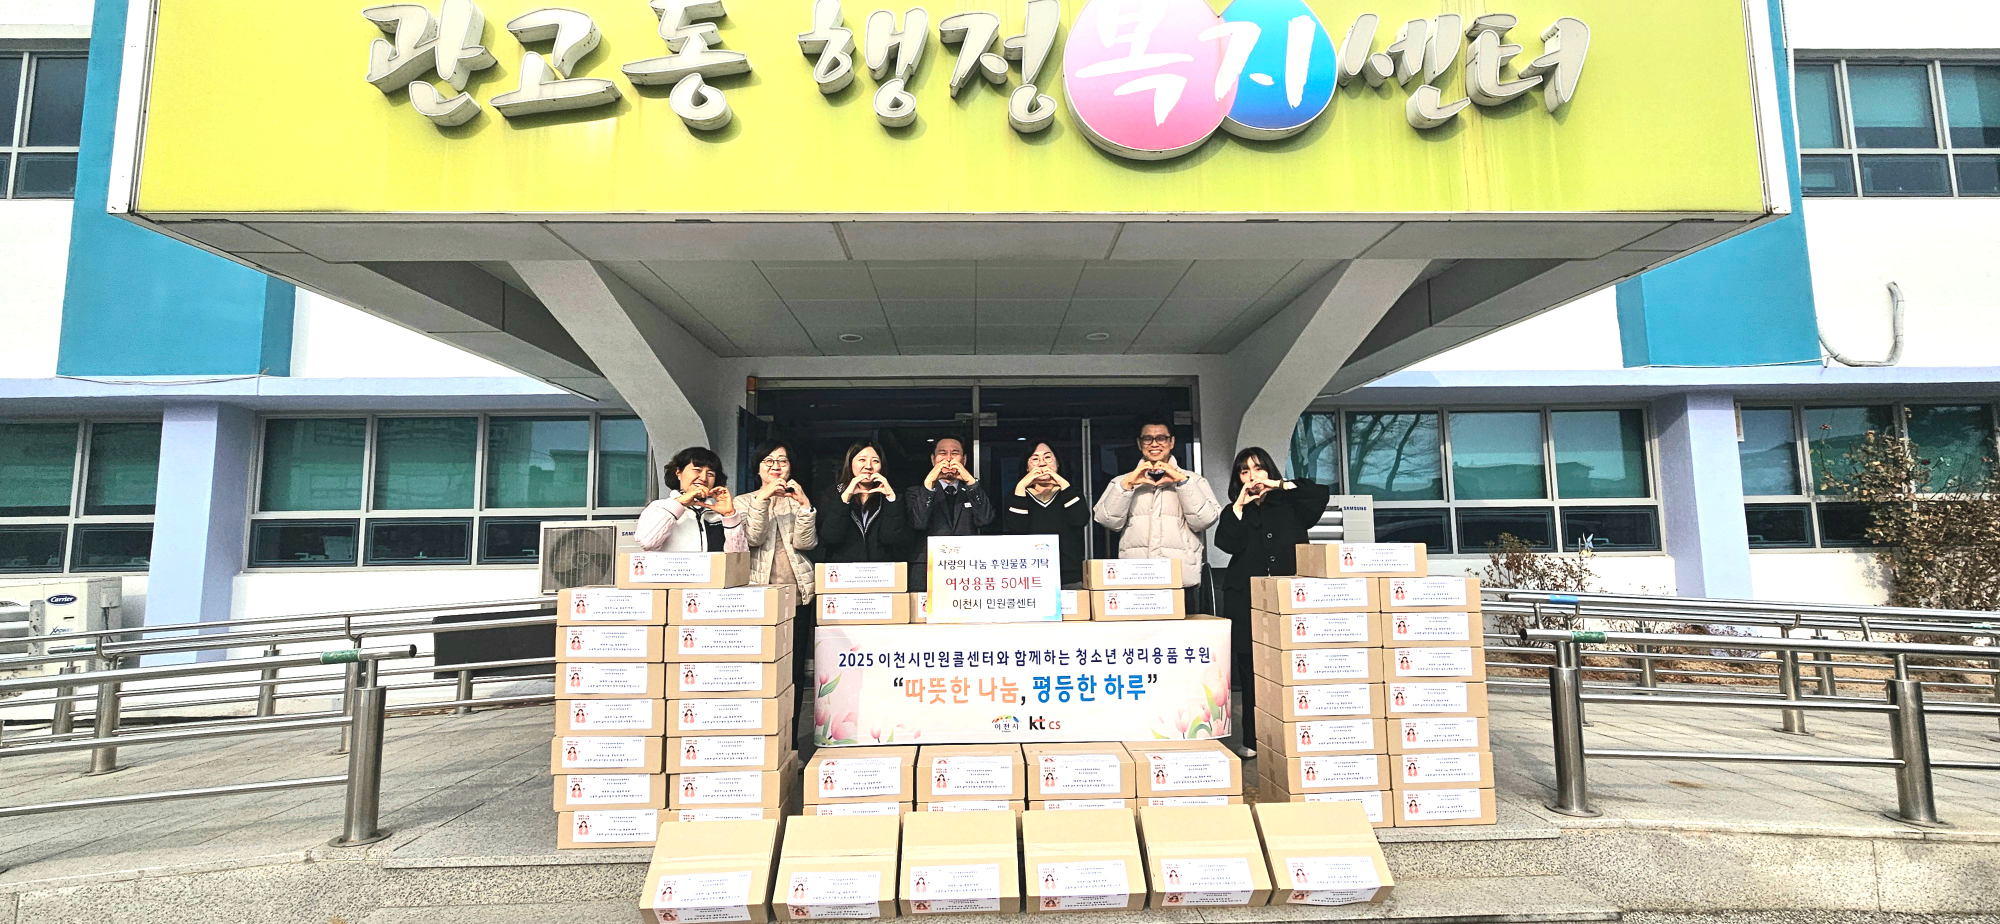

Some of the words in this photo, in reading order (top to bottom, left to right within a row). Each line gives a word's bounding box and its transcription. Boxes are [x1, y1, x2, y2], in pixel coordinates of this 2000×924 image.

[362, 0, 752, 131] 관고동
[938, 559, 966, 570] 사랑의
[969, 560, 988, 570] 나눔
[1031, 558, 1049, 569] 기탁
[945, 577, 997, 591] 여성용품
[1001, 576, 1042, 590] 50세트
[952, 598, 982, 610] 이천시
[986, 597, 1036, 609] 민원콜센터
[838, 652, 874, 668] 2025
[878, 650, 1010, 669] 이천시민원콜센터와
[1014, 649, 1071, 667] 함께하는
[1075, 647, 1118, 666] 청소년
[1122, 646, 1179, 665] 생리용품
[1184, 646, 1211, 664] 후원
[893, 676, 971, 705] “따뜻한
[978, 676, 1026, 706] 나눔,
[1032, 673, 1098, 704] 평등한
[1103, 673, 1158, 701] 하루”
[1029, 716, 1046, 730] kt
